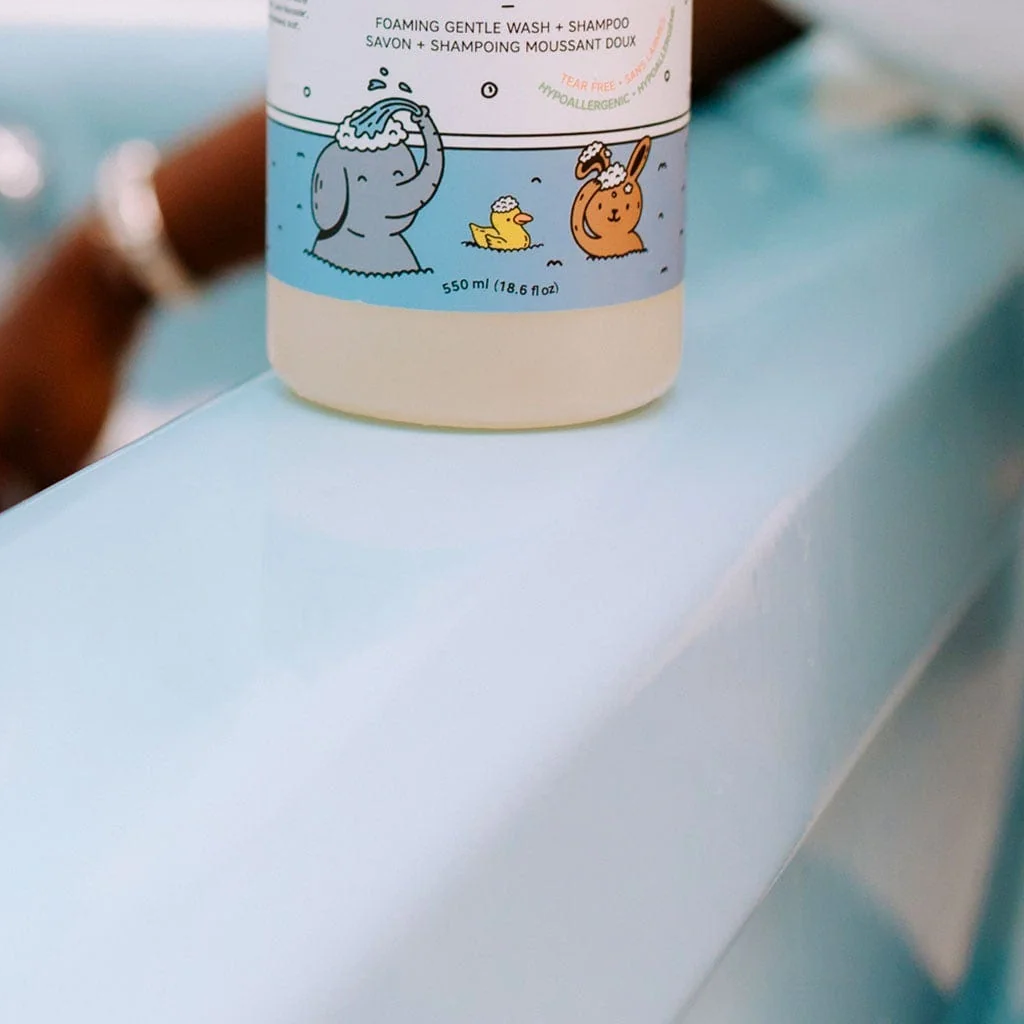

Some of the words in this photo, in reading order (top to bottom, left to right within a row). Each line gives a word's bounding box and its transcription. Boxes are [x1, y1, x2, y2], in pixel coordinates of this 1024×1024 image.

[376, 17, 439, 32] FOAMING
[445, 21, 501, 34] GENTLE
[507, 21, 550, 34] WASH
[555, 23, 563, 32] +
[568, 17, 630, 32] SHAMPOO
[366, 35, 412, 50] SAVON
[417, 40, 425, 49] +
[430, 39, 520, 53] SHAMPOING
[525, 38, 602, 53] MOUSSANT
[605, 35, 636, 49] DOUX
[561, 72, 589, 91] TEAR
[591, 80, 616, 92] FREE
[537, 81, 631, 111] HYPOALLERGENIC
[442, 279, 469, 294] 550
[472, 278, 489, 289] ml
[494, 279, 528, 296] (18.6
[541, 281, 559, 296] oz)
